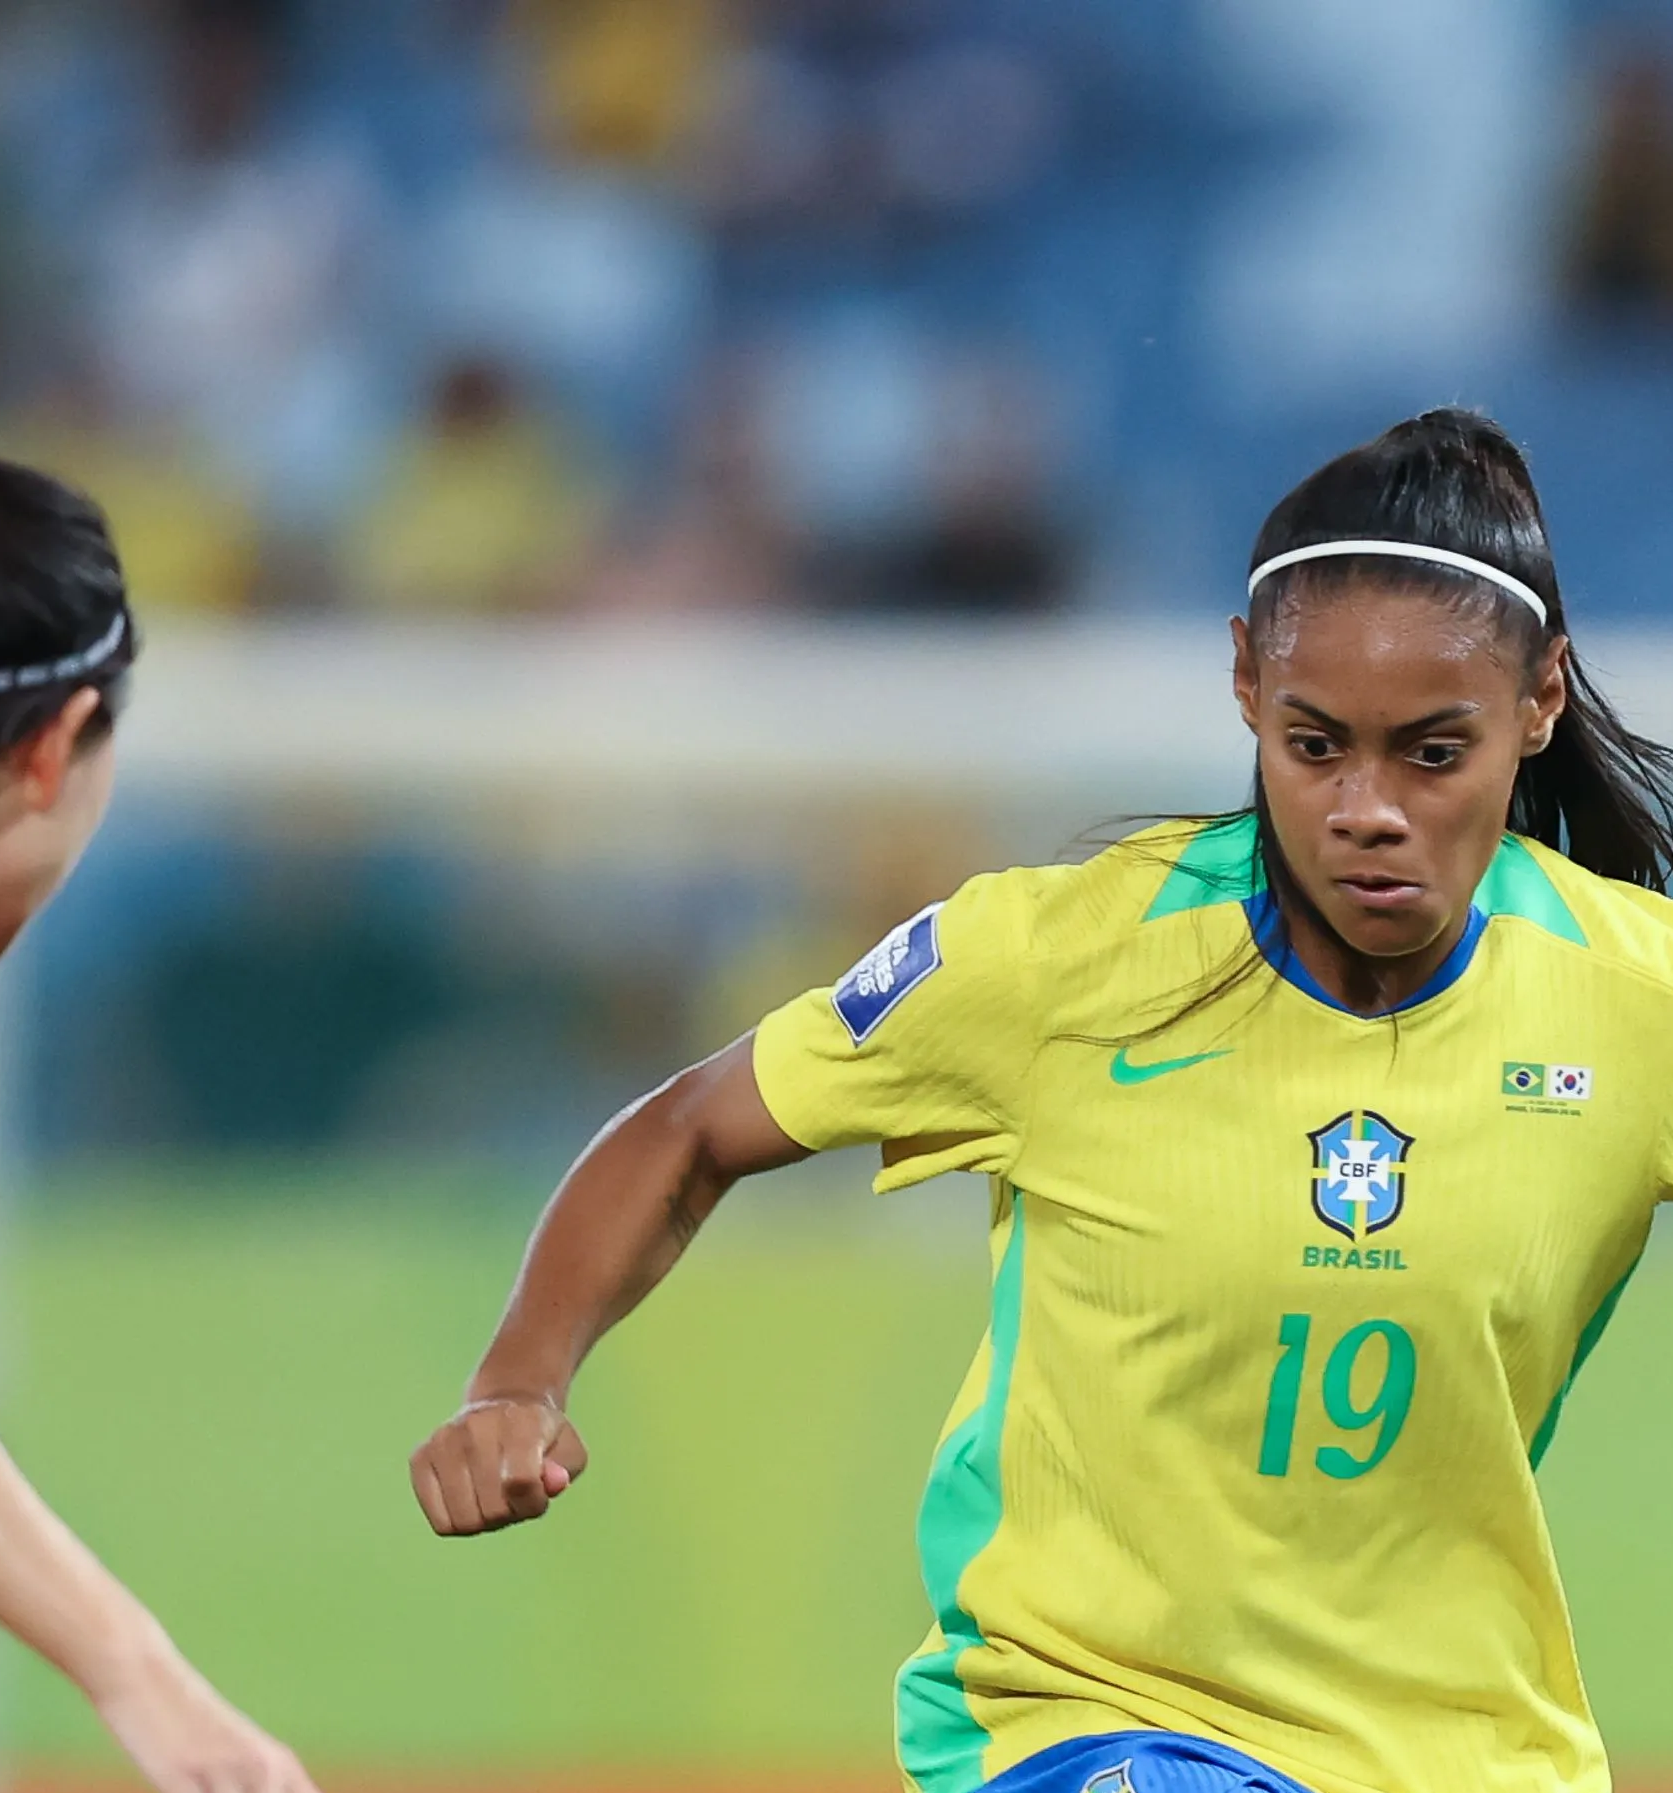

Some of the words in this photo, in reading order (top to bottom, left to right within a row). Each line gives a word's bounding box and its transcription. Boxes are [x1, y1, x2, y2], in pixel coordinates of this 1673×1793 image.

[1339, 1162, 1378, 1178] CBF
[1302, 1245, 1409, 1270] BRASIL
[1257, 1313, 1417, 1480] 19
